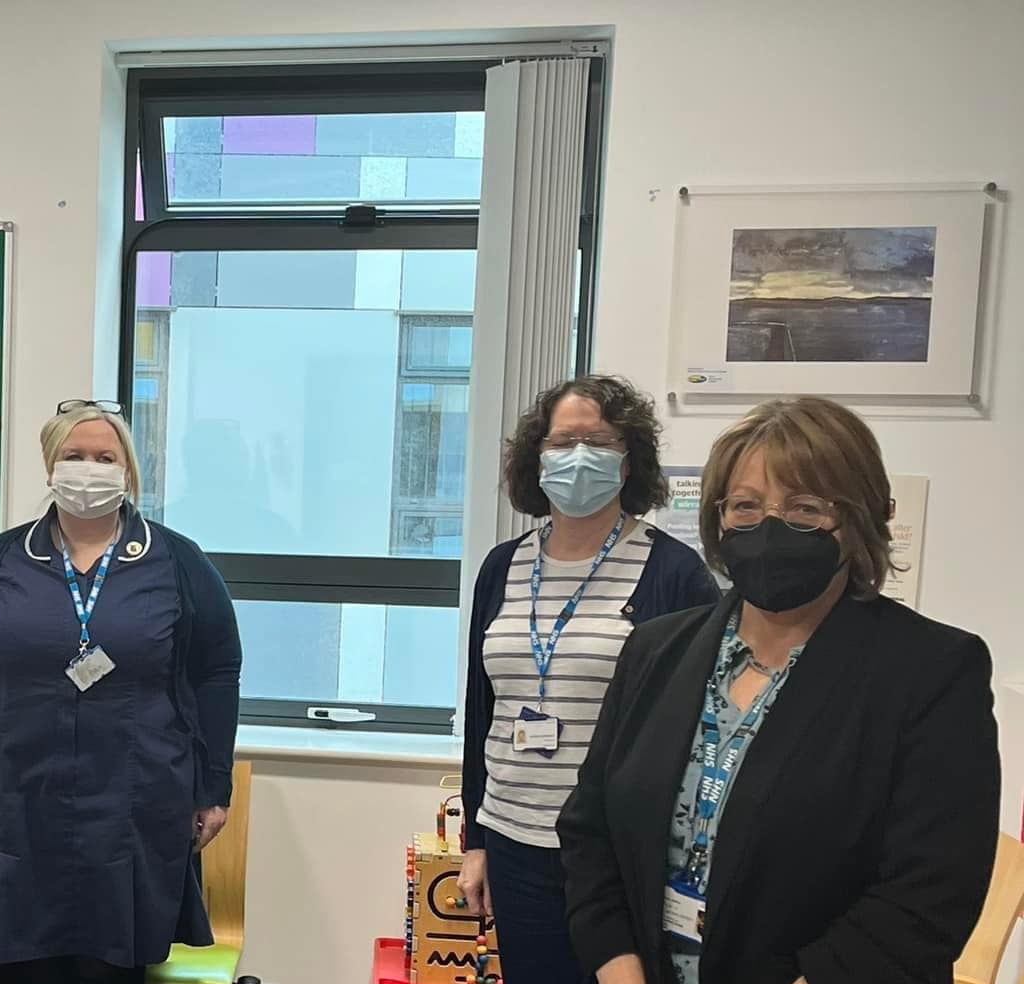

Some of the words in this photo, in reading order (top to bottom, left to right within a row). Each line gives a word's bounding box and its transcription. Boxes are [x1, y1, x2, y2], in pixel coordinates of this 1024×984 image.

[703, 743, 716, 768] NHS
[721, 749, 738, 771] NHS
[701, 776, 714, 800] NHS
[709, 778, 724, 803] NHS
